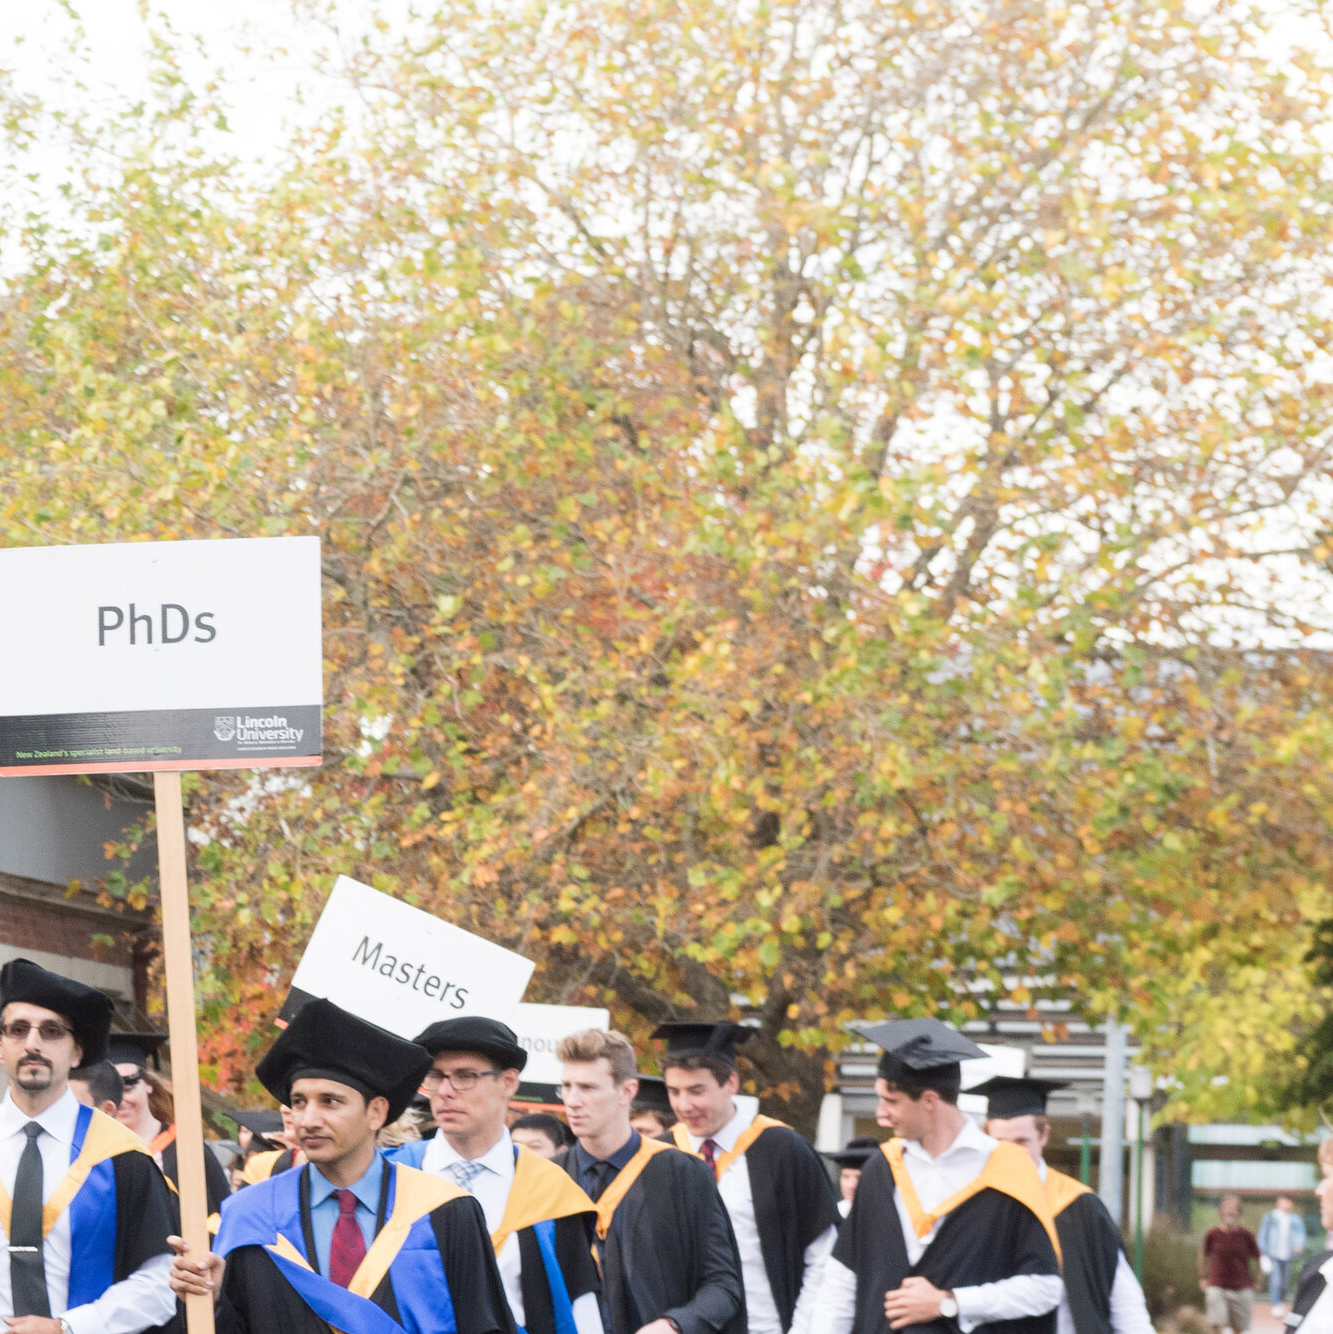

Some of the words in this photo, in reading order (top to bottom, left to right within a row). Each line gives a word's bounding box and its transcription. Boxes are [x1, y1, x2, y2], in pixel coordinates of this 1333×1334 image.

[98, 602, 217, 646] PhDs
[236, 715, 287, 728] Lincoln
[236, 727, 304, 742] University
[352, 936, 469, 1010] Masters
